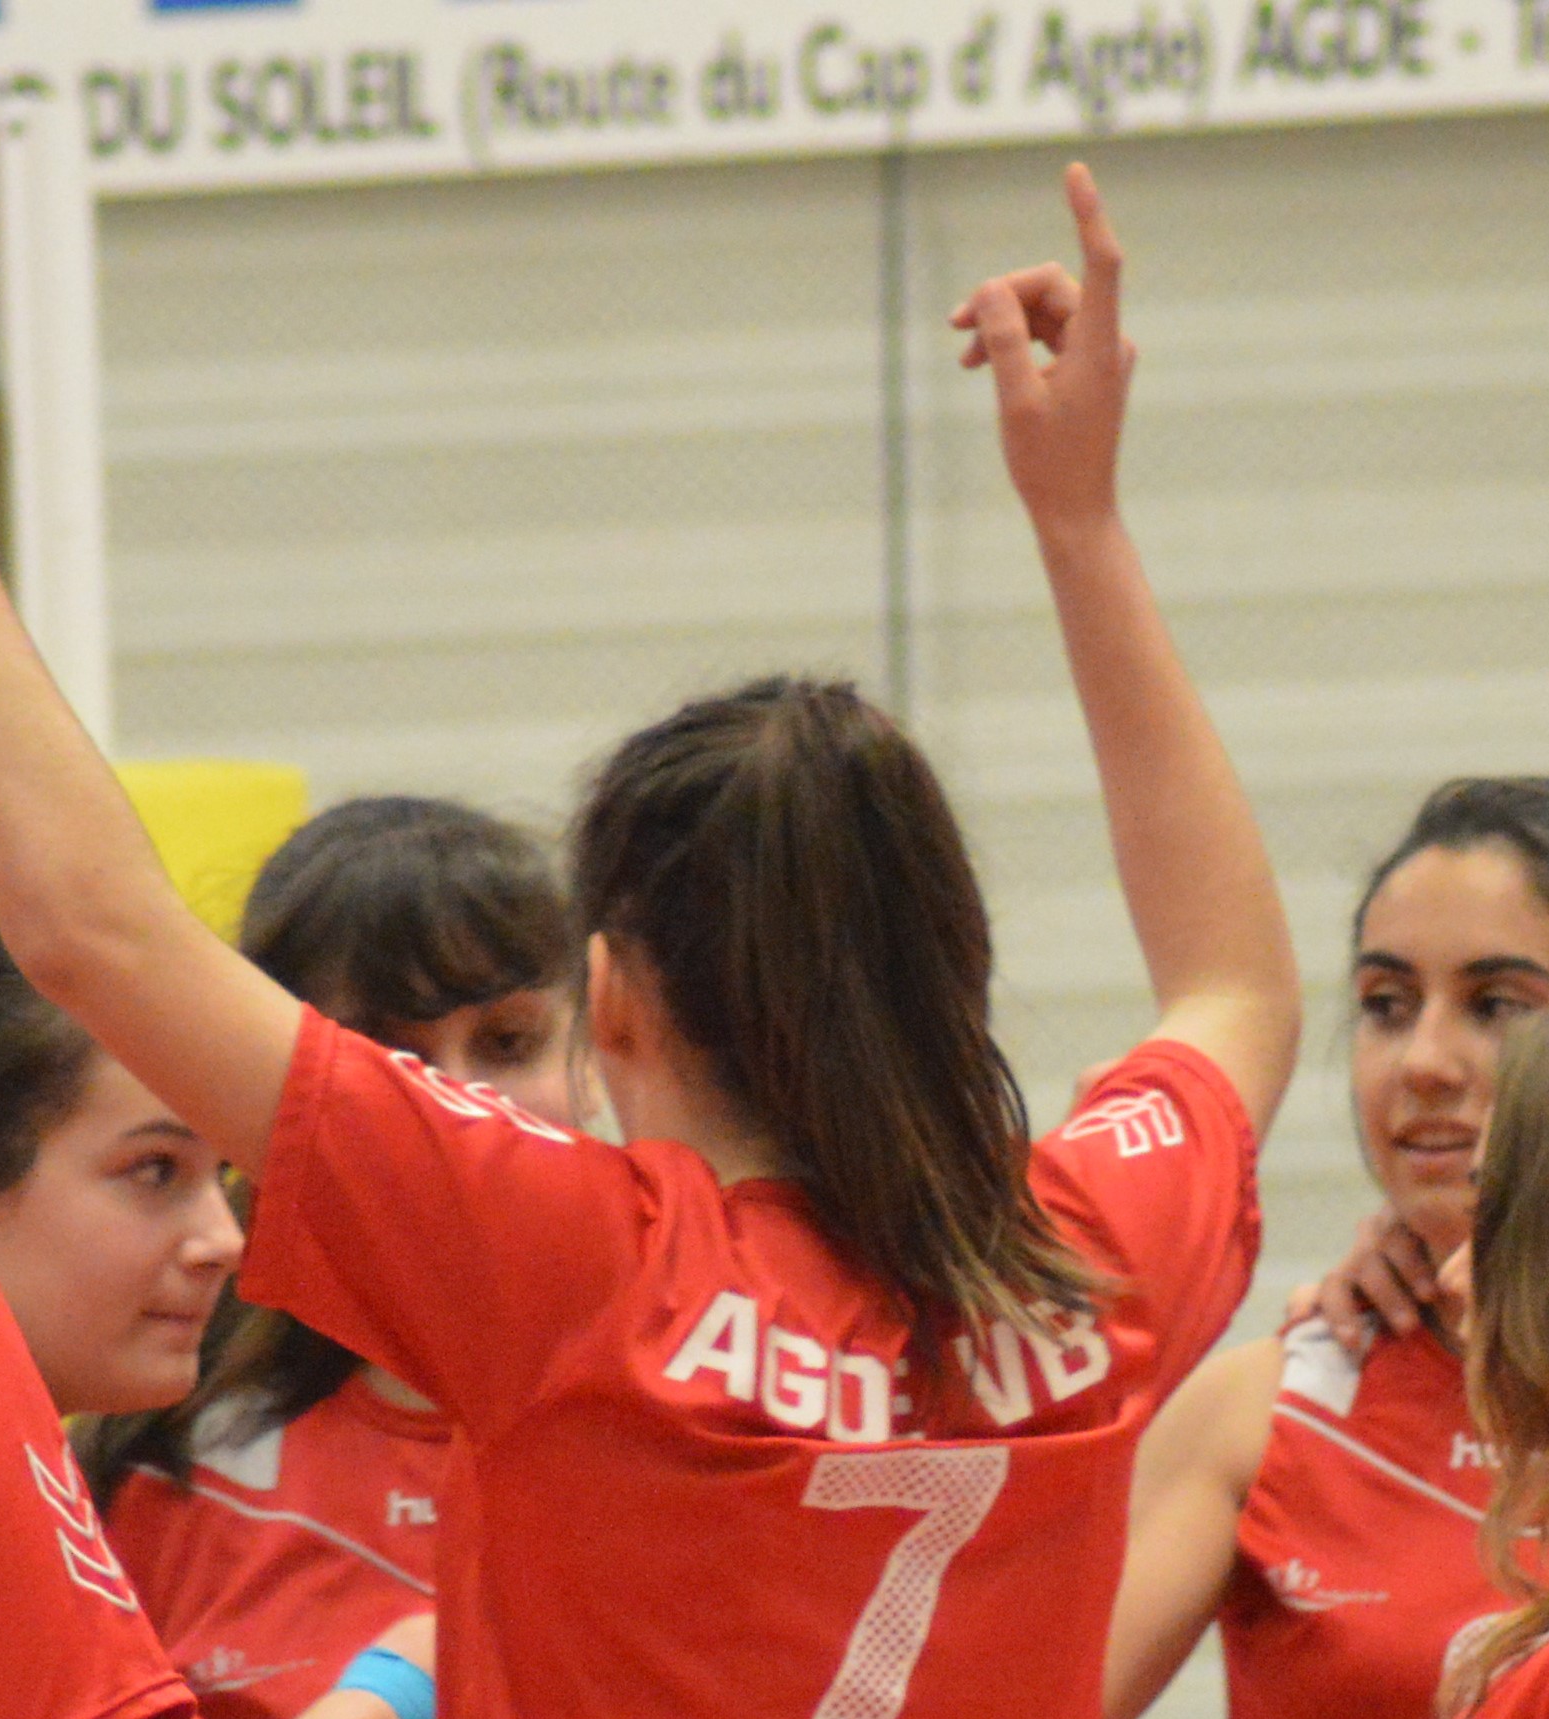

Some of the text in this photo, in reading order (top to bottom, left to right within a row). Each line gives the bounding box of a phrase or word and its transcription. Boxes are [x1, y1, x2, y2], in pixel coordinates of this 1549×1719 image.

[86, 68, 187, 156] DU
[210, 47, 438, 150] SOLEIL
[456, 40, 673, 170] (Route
[702, 33, 780, 119] du
[799, 23, 930, 142] Cap
[1244, 0, 1433, 78] AGDE
[955, 1300, 1113, 1427] VB
